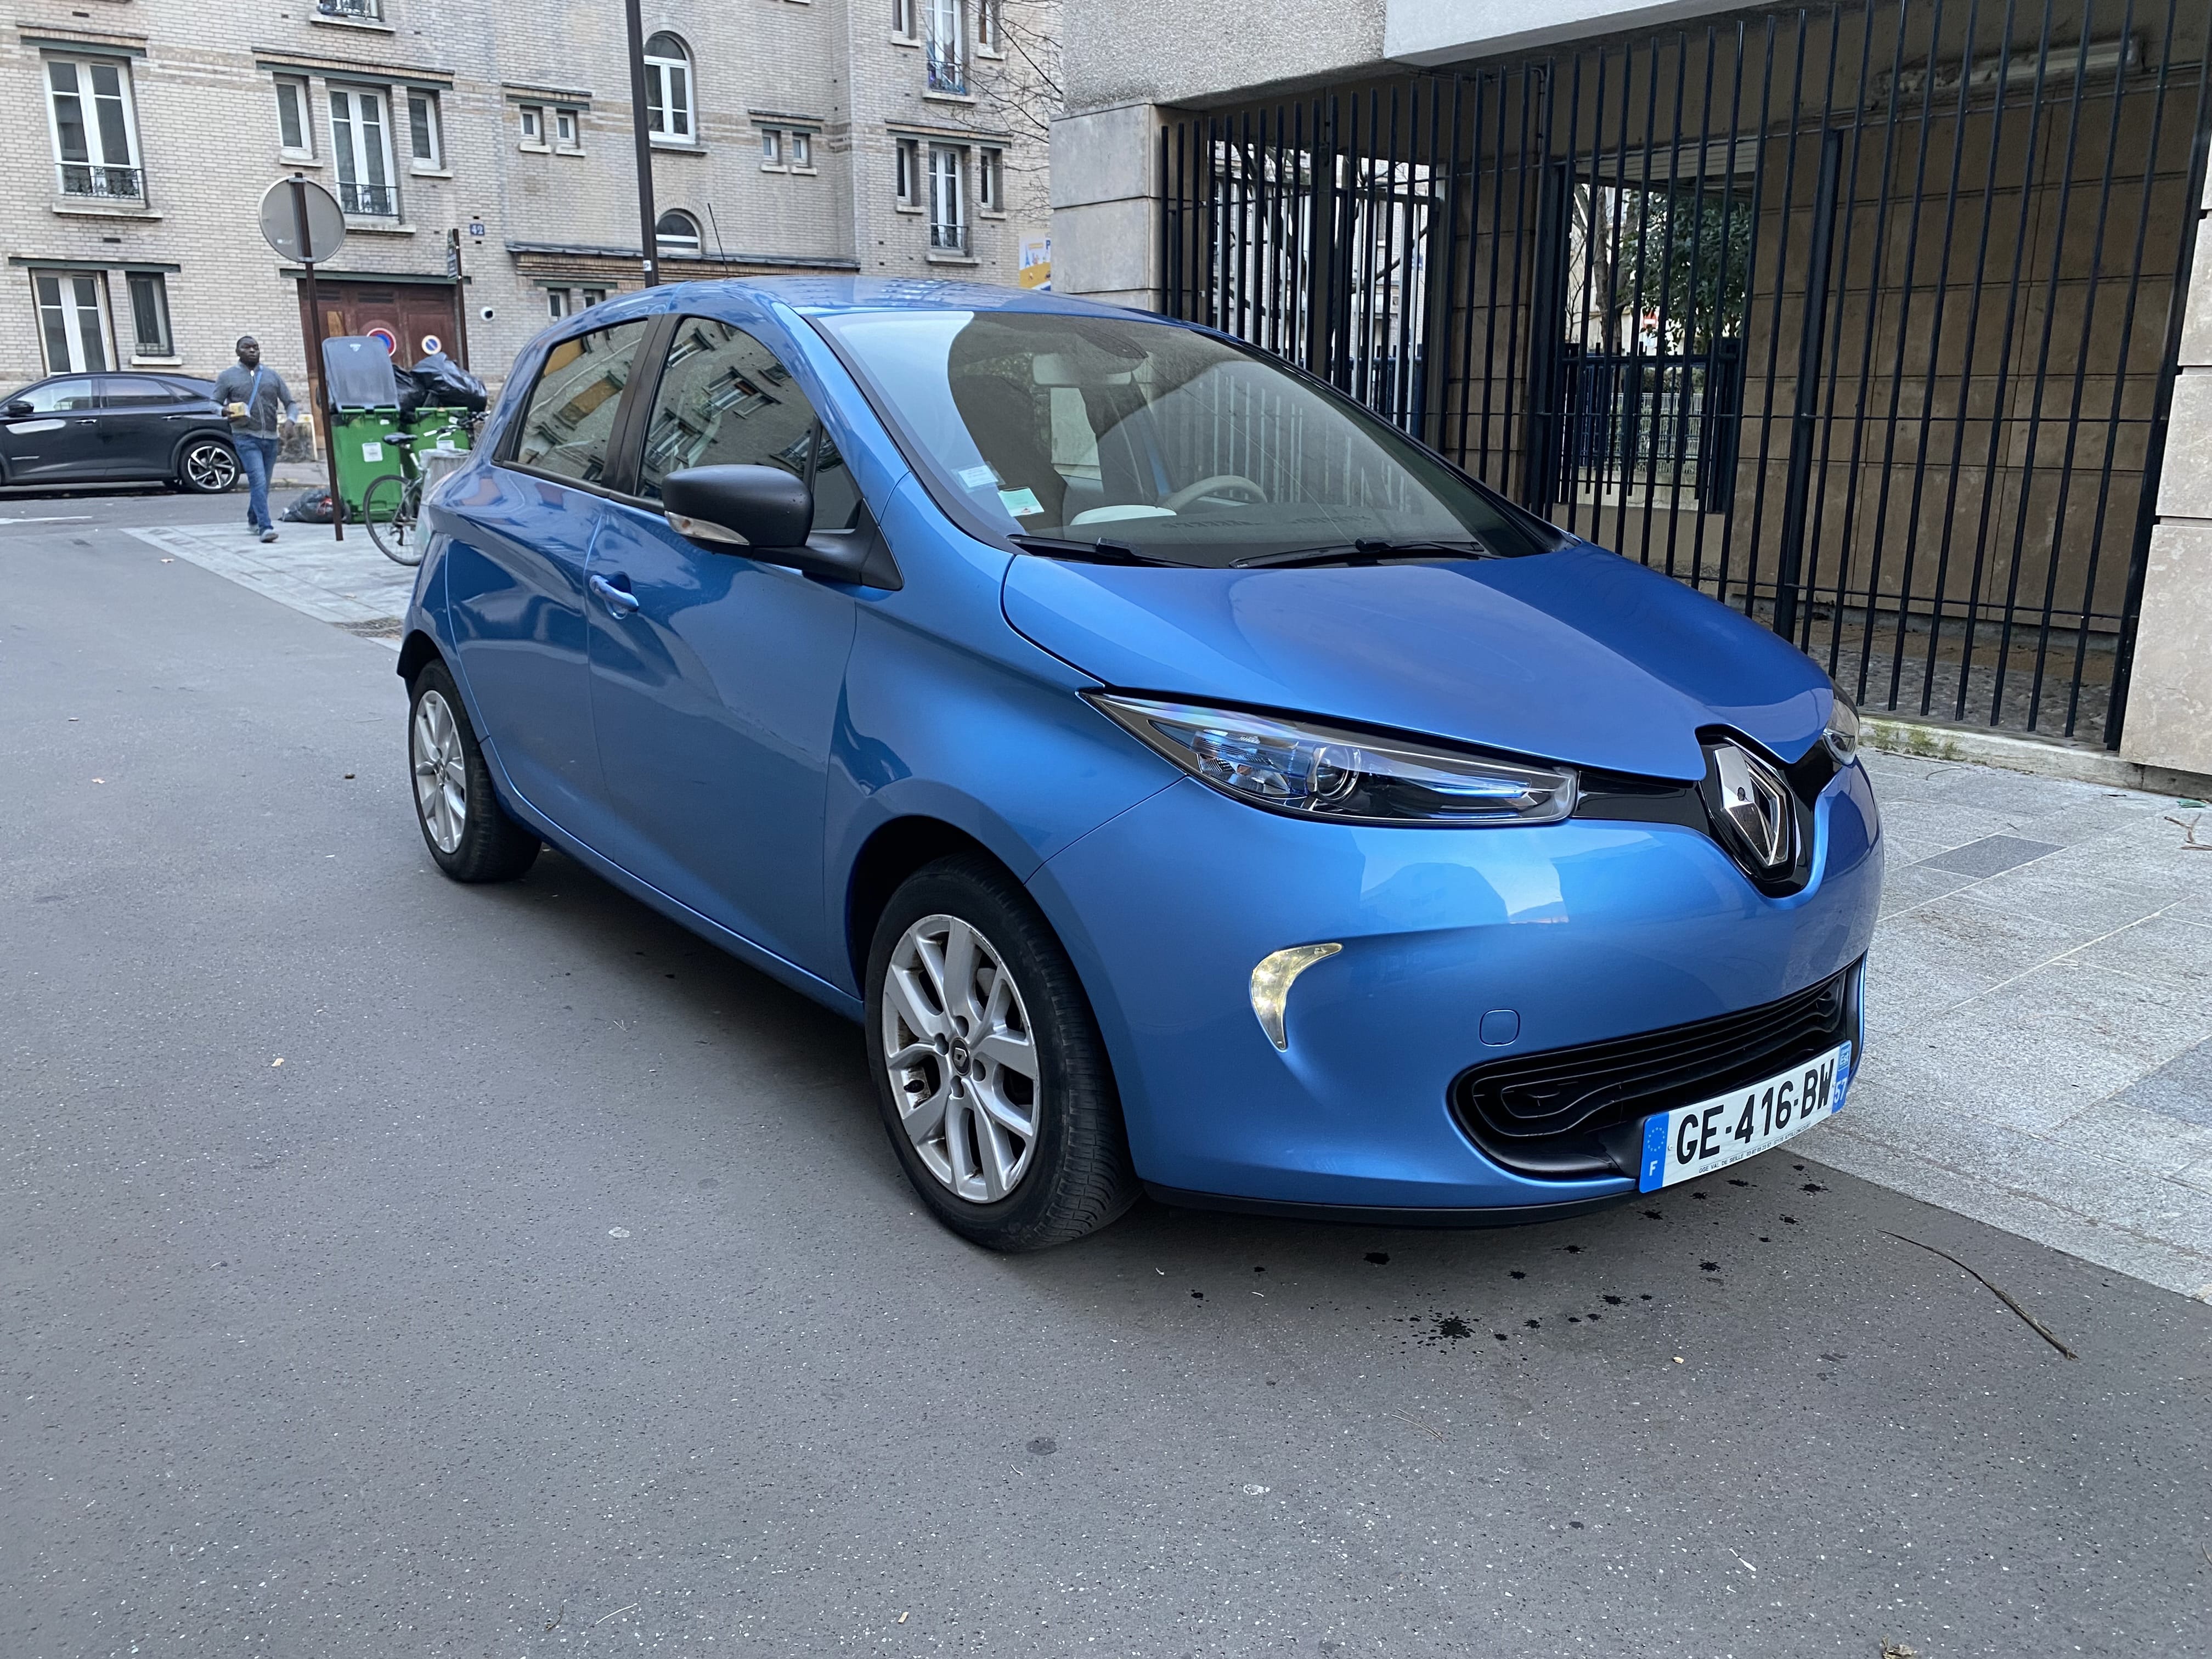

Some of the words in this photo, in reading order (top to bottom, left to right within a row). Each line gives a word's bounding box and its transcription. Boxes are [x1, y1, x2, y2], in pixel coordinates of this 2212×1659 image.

[471, 224, 483, 235] 42
[1834, 1076, 1848, 1104] 57
[1729, 1153, 1744, 1163] SEILLE
[1649, 1160, 1658, 1176] F
